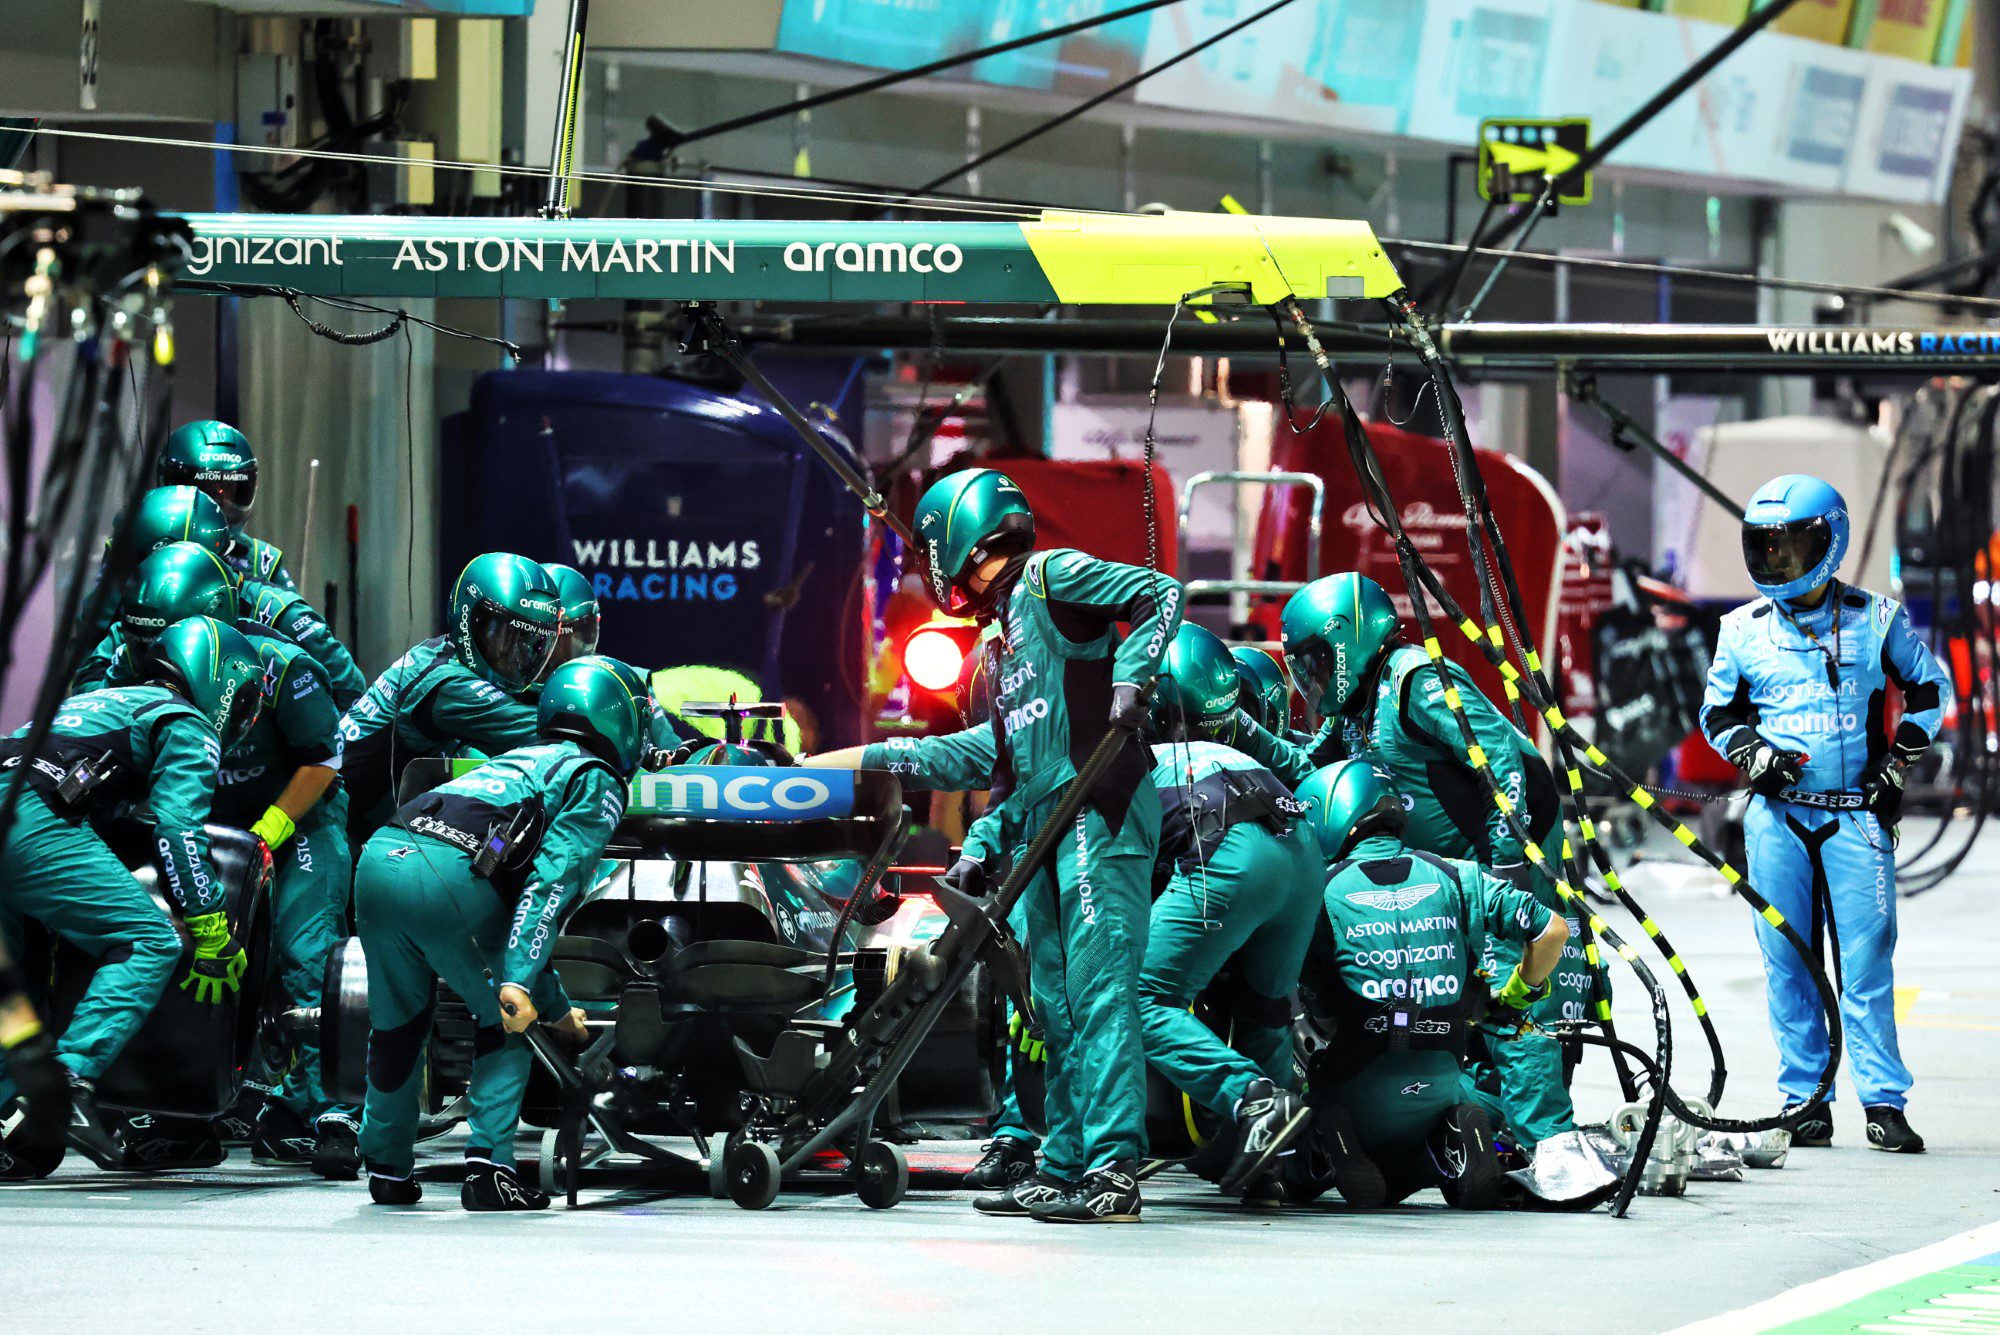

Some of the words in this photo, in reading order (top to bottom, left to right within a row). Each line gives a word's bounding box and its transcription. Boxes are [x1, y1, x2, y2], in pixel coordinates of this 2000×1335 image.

[187, 235, 343, 275] gnizant
[392, 237, 544, 272] ASTON
[562, 238, 735, 274] MARTIN
[784, 241, 963, 273] aramco
[1767, 331, 1914, 354] WILLIAMS
[199, 452, 242, 464] aramco
[194, 472, 221, 482] ASTON
[222, 472, 249, 482] MARTIN
[572, 539, 761, 569] WILLIAMS
[928, 538, 945, 603] cognizant
[1811, 533, 1841, 589] cognizant
[593, 572, 739, 601] RACING
[126, 614, 166, 628] aramco
[519, 597, 558, 616] aramco
[1147, 587, 1180, 658] aramco
[460, 603, 477, 669] cognizant
[509, 618, 537, 634] ASTON
[1334, 642, 1350, 703] cognizant
[214, 678, 236, 733] cogniza
[1205, 686, 1240, 710] aramco
[1762, 679, 1858, 705] cognizant
[1766, 712, 1858, 734] aramco
[629, 774, 830, 811] mco
[158, 837, 187, 907] aramco
[180, 829, 212, 906] cognizant
[295, 835, 314, 873] ASTO
[1076, 871, 1096, 925] ASTON
[1874, 865, 1888, 915] ASTON
[508, 881, 540, 949] aramco
[529, 882, 564, 960] cognizant
[1346, 920, 1397, 940] ASTON
[1400, 916, 1457, 935] MARTIN
[1355, 941, 1456, 971] cognizant
[1361, 974, 1459, 999] aramco
